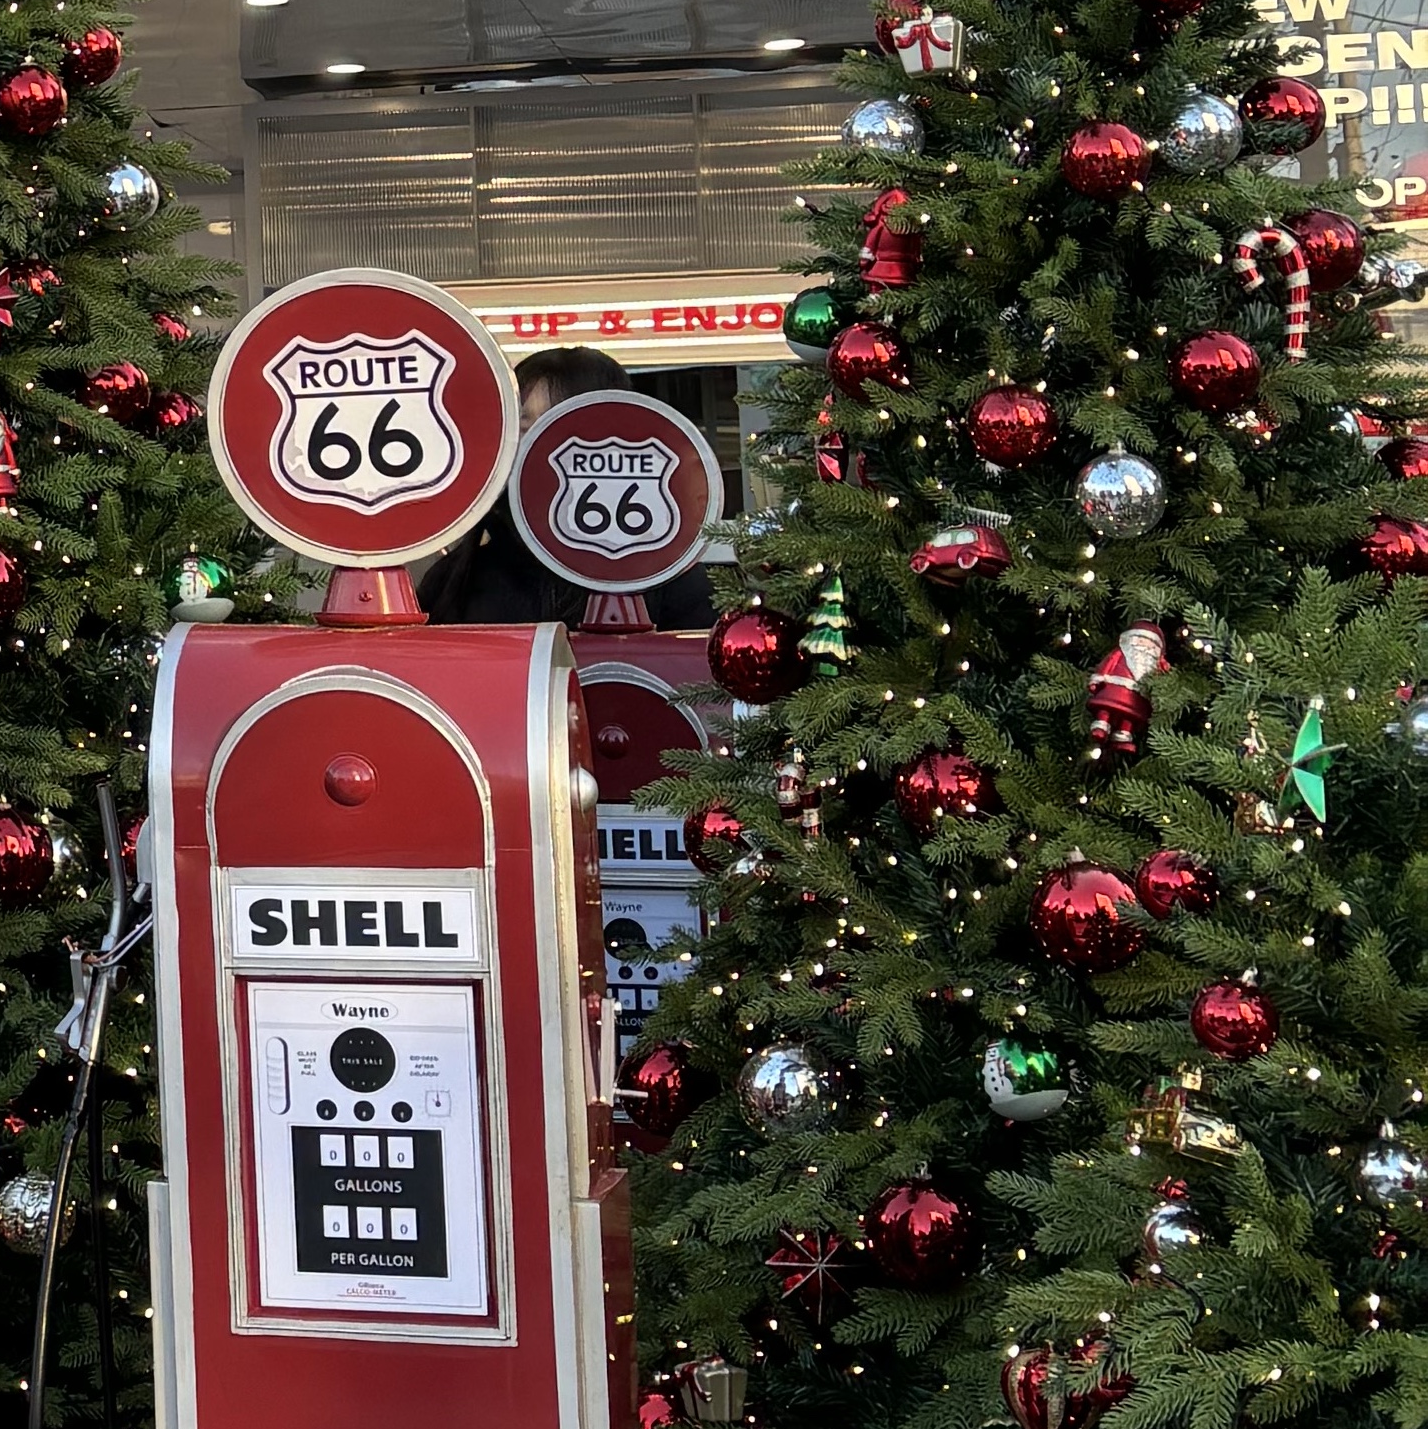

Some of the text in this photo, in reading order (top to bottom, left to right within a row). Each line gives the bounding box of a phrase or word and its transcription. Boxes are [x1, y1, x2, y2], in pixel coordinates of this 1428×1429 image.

[511, 302, 784, 338] UP & ENJO
[299, 354, 419, 390] ROUTE
[306, 398, 424, 482] 66
[572, 452, 654, 475] ROUTE
[574, 481, 654, 537] 66
[248, 898, 459, 949] SHELL
[332, 1003, 390, 1020] Wayne
[334, 1178, 403, 1194] GALLONS
[331, 1252, 414, 1268] PER GALLON
